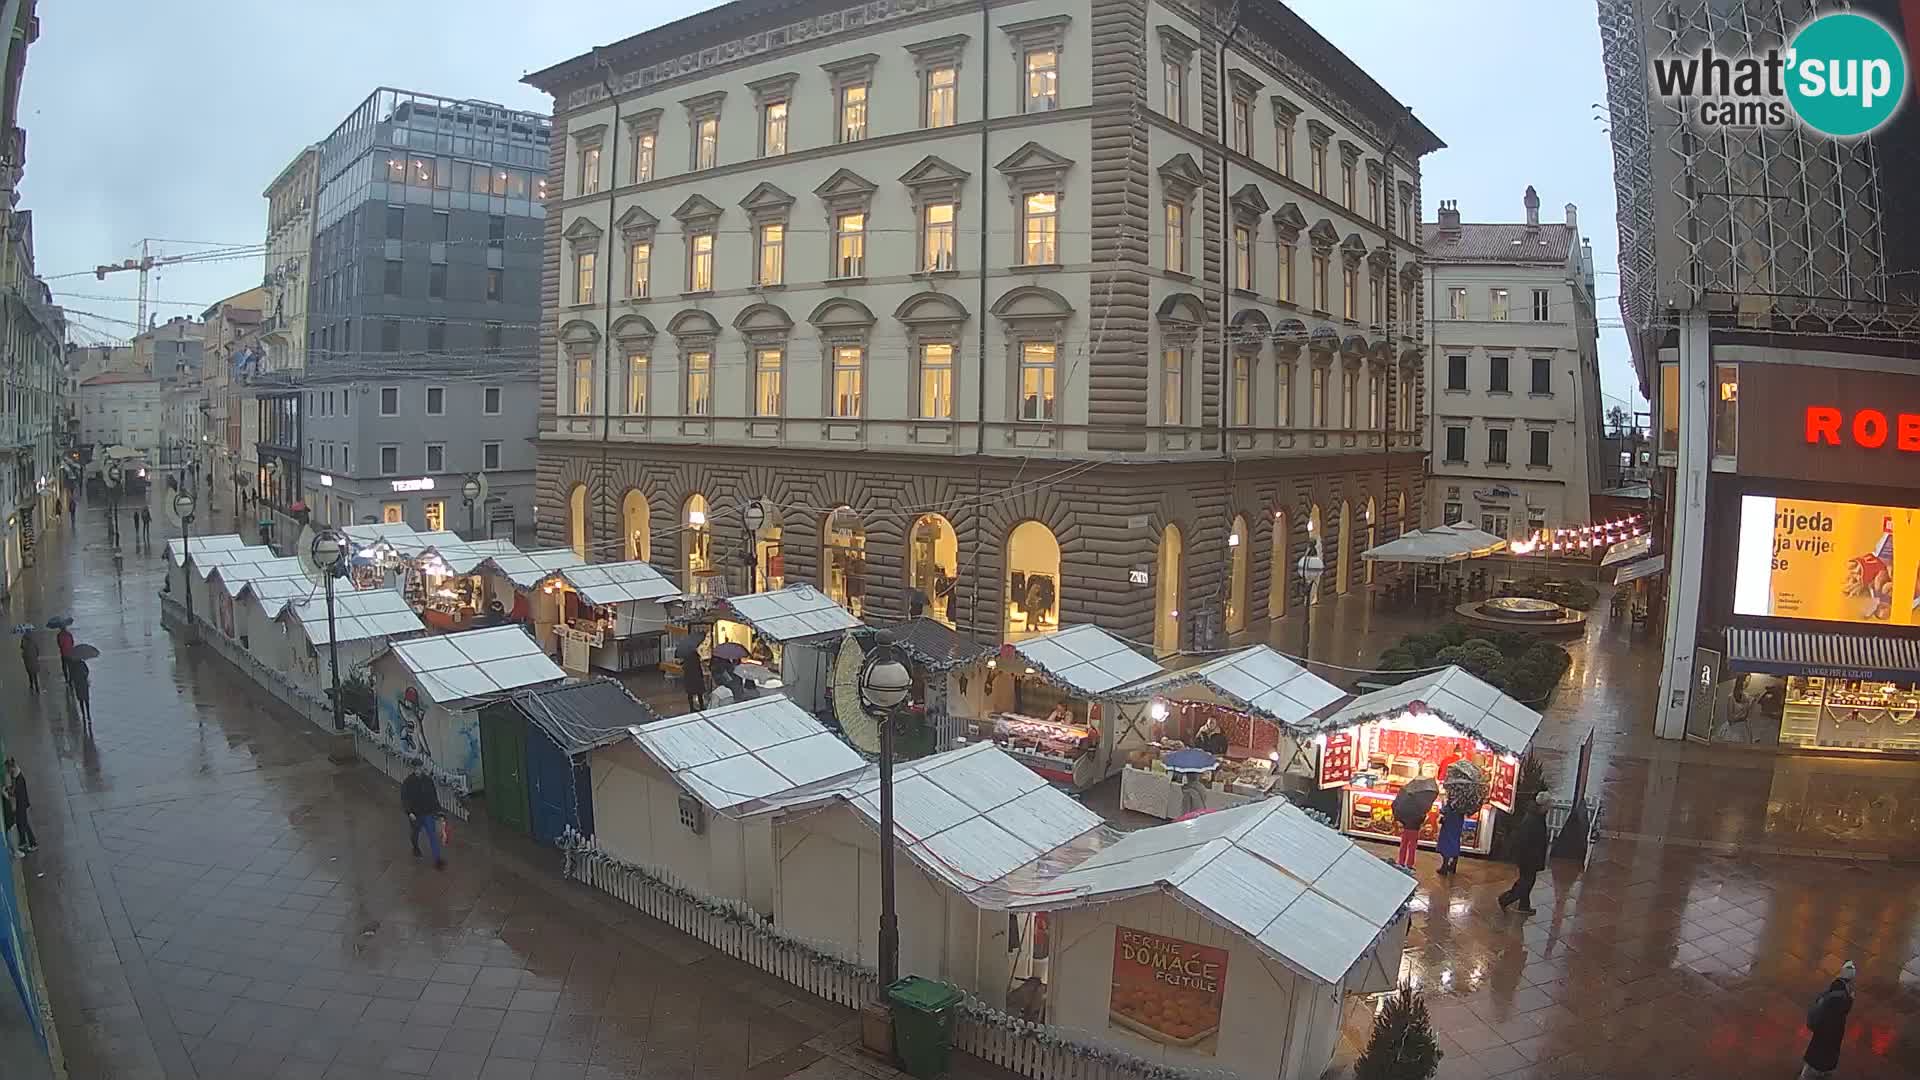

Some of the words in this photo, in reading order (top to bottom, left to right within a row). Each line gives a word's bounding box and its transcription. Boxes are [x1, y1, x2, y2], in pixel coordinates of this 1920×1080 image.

[1806, 406, 1920, 452] ROB
[1122, 943, 1220, 980] DOMAĆE
[1155, 971, 1217, 993] FRITULE
